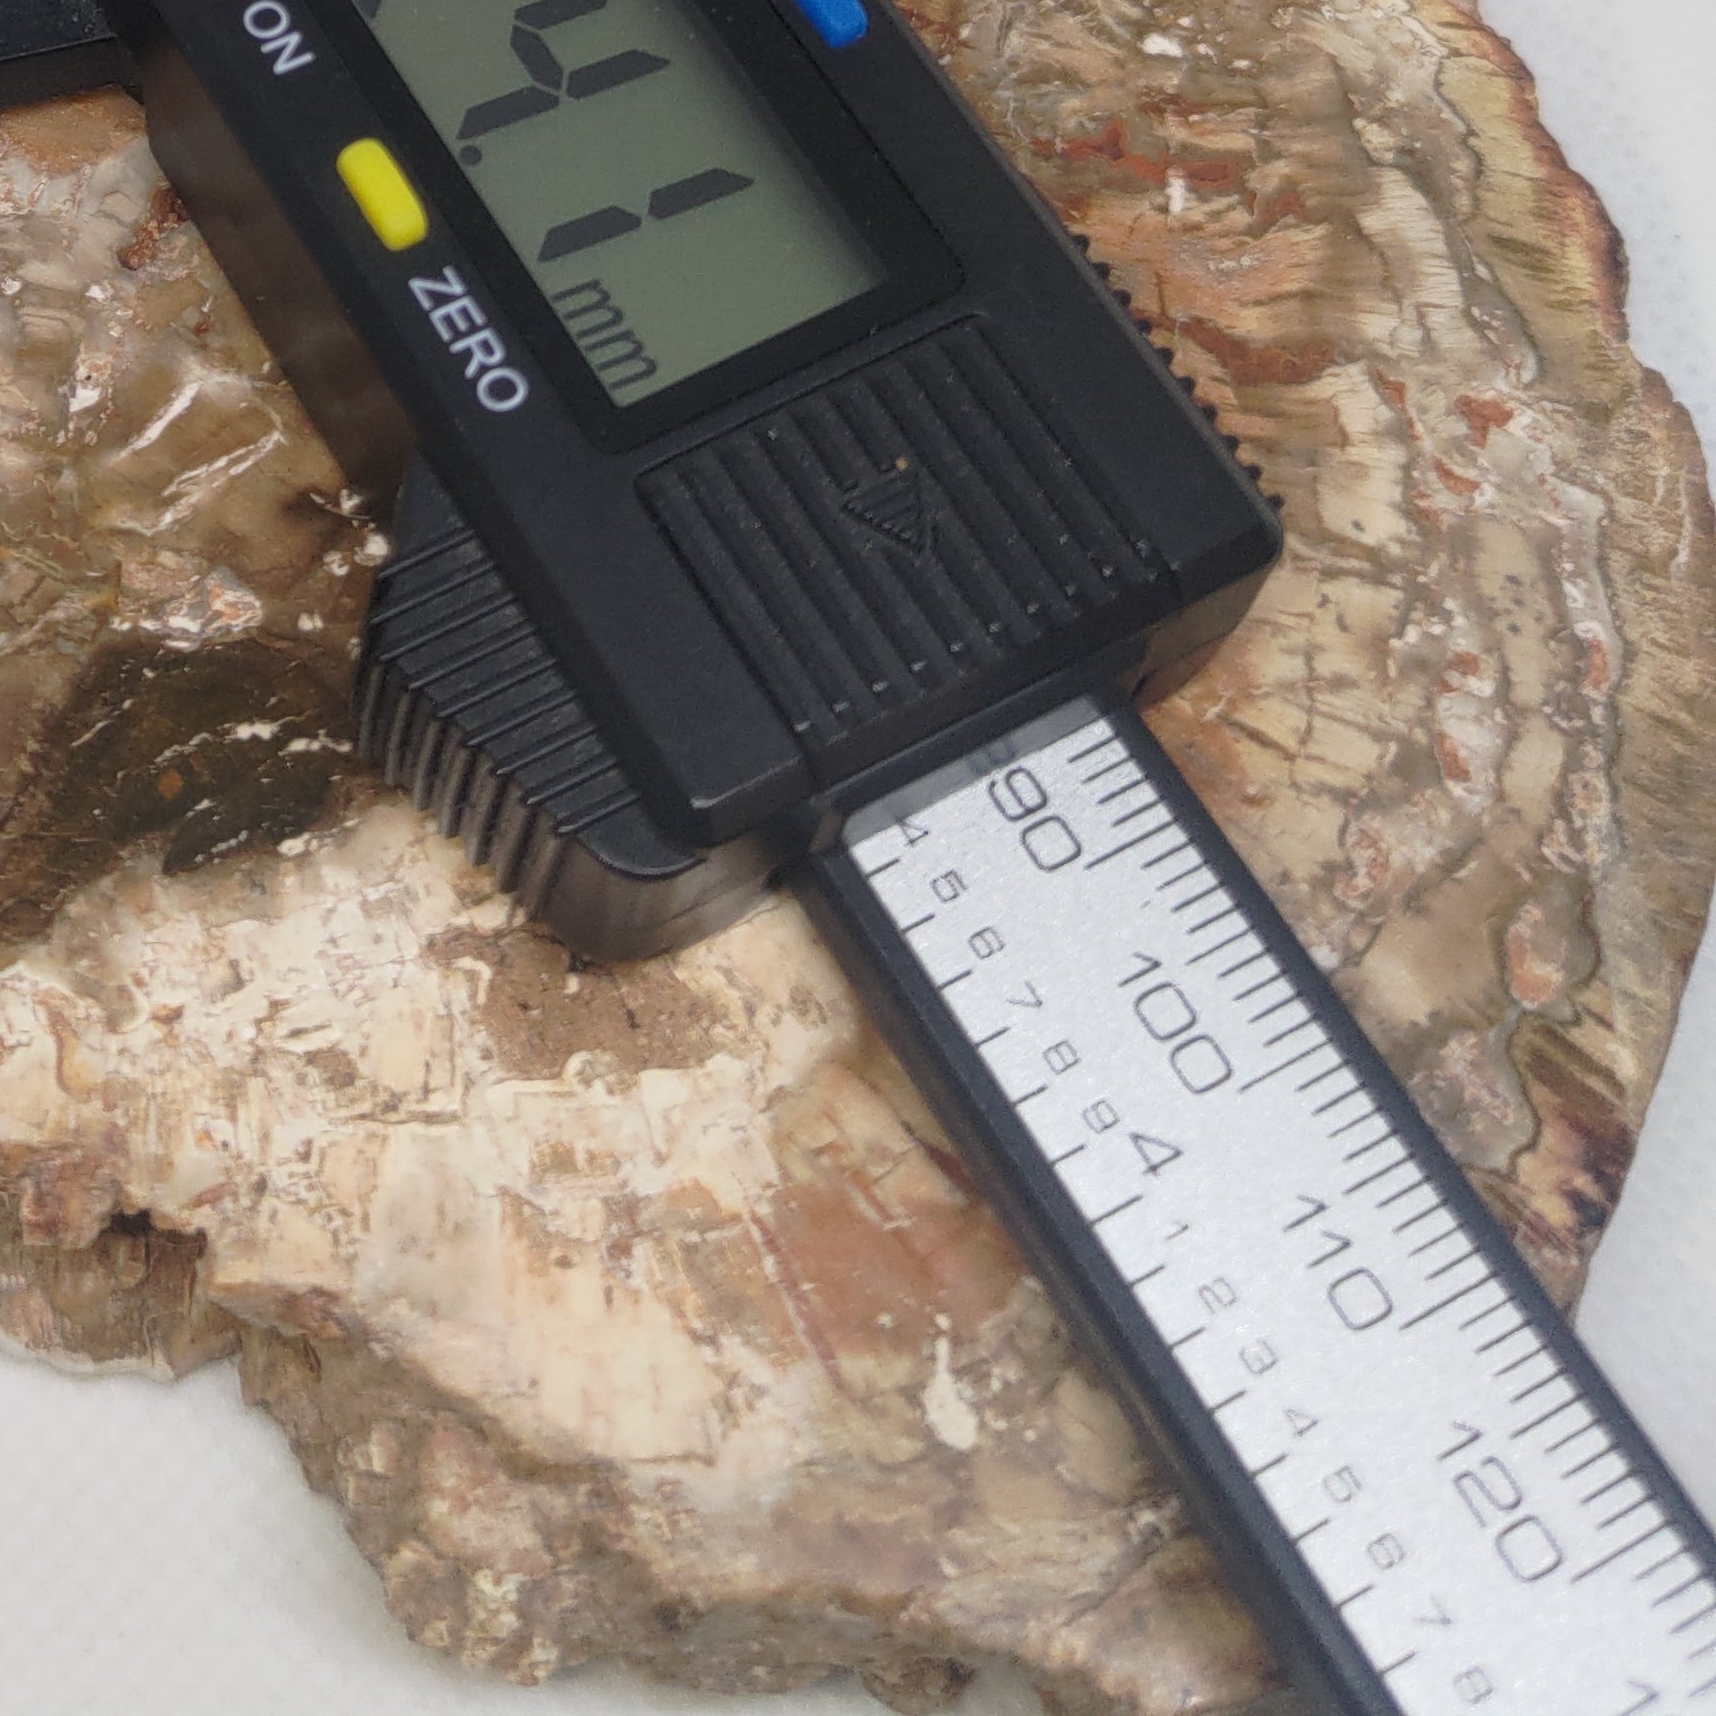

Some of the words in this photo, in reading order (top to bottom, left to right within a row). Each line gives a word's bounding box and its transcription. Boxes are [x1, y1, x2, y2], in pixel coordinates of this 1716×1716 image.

[243, 0, 316, 76] ON
[408, 264, 530, 413] ZERO
[553, 279, 658, 389] mm
[989, 767, 1082, 871] 90
[930, 869, 968, 902] 5
[969, 925, 1005, 960] 6
[1006, 981, 1044, 1012] 7
[1118, 951, 1233, 1094] 100
[1042, 1039, 1081, 1075] 8
[1130, 1132, 1183, 1176] 4
[1284, 1194, 1394, 1331] 110
[1198, 1277, 1238, 1314] 2
[1284, 1407, 1319, 1438] 4
[1322, 1465, 1363, 1503] 5
[1438, 1420, 1563, 1582] 120
[1367, 1532, 1406, 1570] 6
